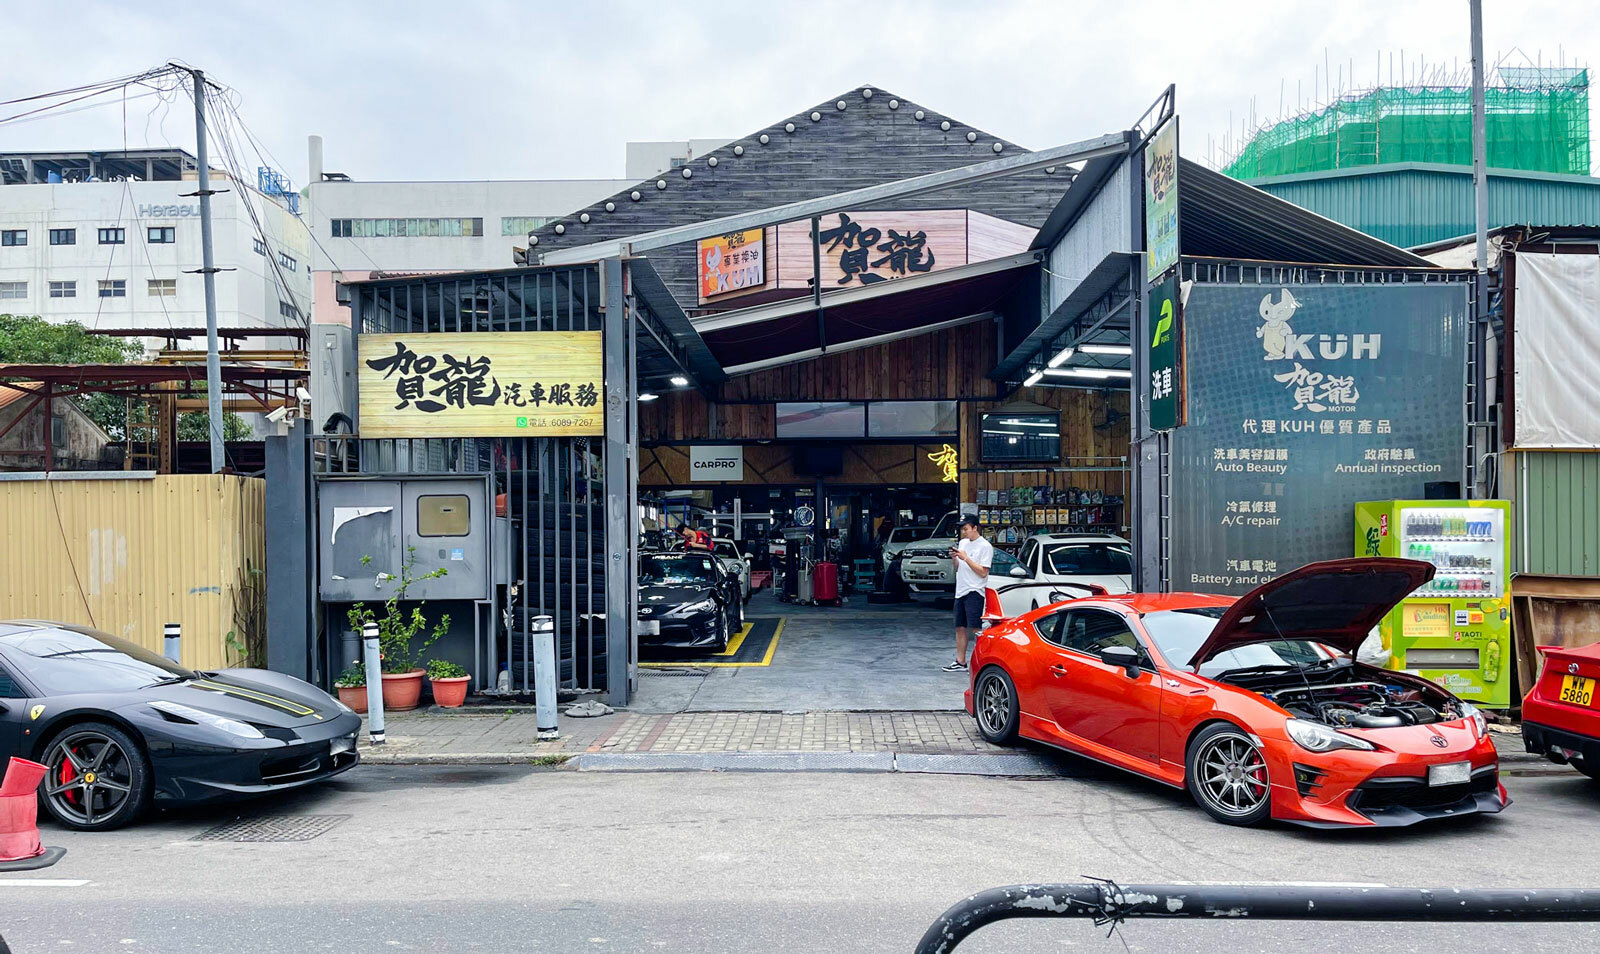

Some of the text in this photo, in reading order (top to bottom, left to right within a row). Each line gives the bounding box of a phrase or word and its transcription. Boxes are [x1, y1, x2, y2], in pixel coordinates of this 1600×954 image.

[139, 204, 200, 217] Heraeu
[809, 213, 935, 285] 賀龍
[365, 342, 501, 413] 賀龍
[1152, 366, 1172, 400] 洗車
[1273, 362, 1360, 412] 賀龍
[503, 381, 599, 408] 汽車服務
[1364, 448, 1416, 460] 政府驗車
[1214, 462, 1287, 475] Auto Beauty
[1334, 463, 1441, 475] Annual inspection
[1226, 501, 1277, 513] 冷氣修理
[1221, 515, 1281, 527] A/C repair
[1226, 560, 1277, 572] 汽車電池
[1190, 573, 1233, 586] Battery
[1235, 575, 1258, 584] and
[1562, 688, 1590, 704] 5880
